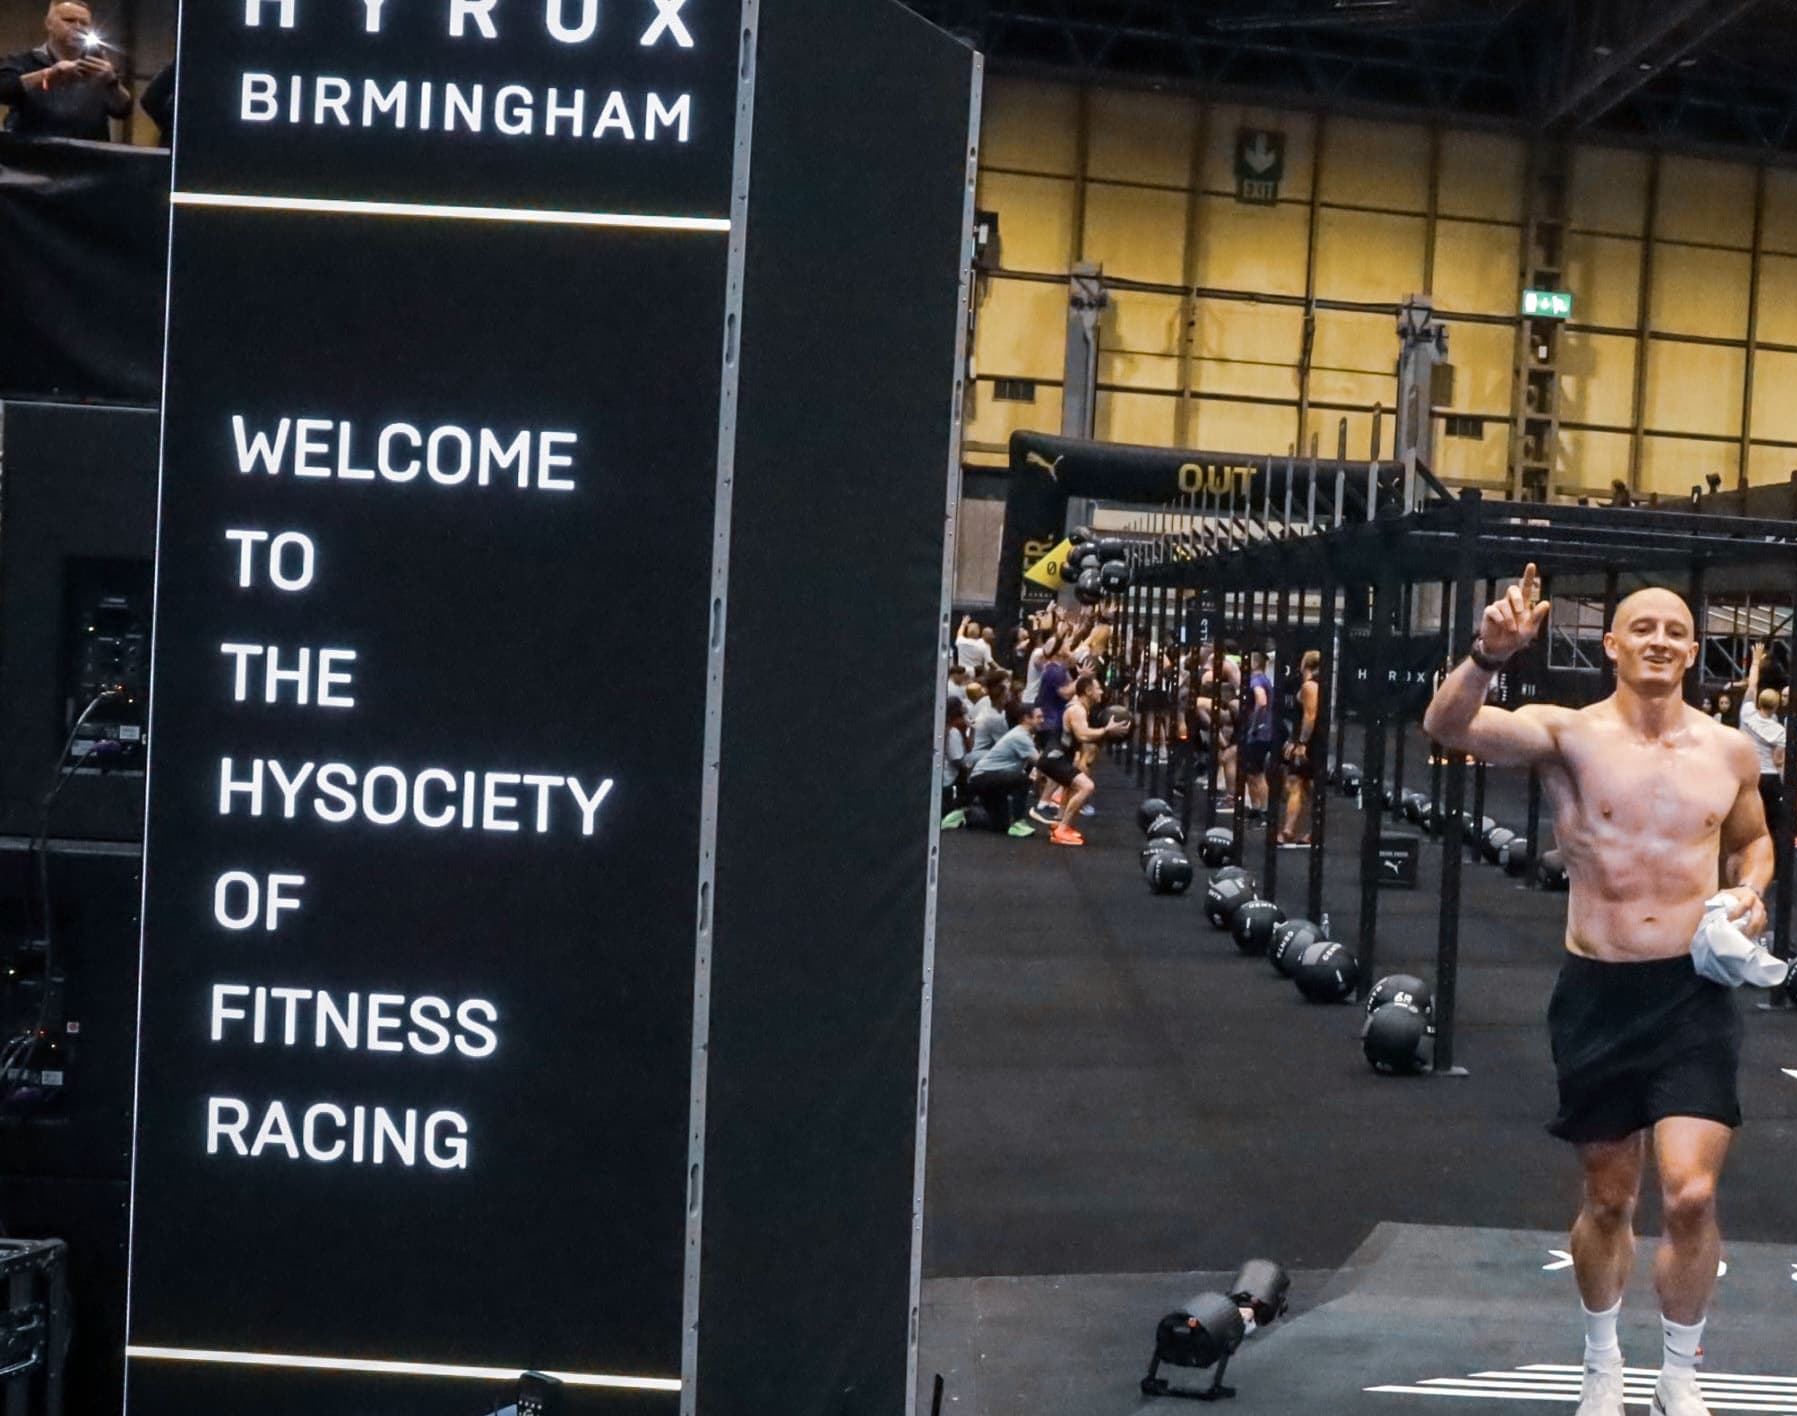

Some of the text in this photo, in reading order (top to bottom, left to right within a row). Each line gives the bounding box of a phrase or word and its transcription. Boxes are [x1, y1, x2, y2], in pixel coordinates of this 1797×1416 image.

[240, 72, 691, 143] BIRMINGHAM
[231, 414, 578, 491] WELCOME
[1178, 463, 1257, 495] OUT
[225, 529, 315, 592] TO
[220, 642, 357, 708] THE
[219, 756, 614, 836] HYSOCIETY
[214, 870, 306, 931] OF
[210, 983, 498, 1058] FITNESS
[206, 1096, 468, 1169] RACING
